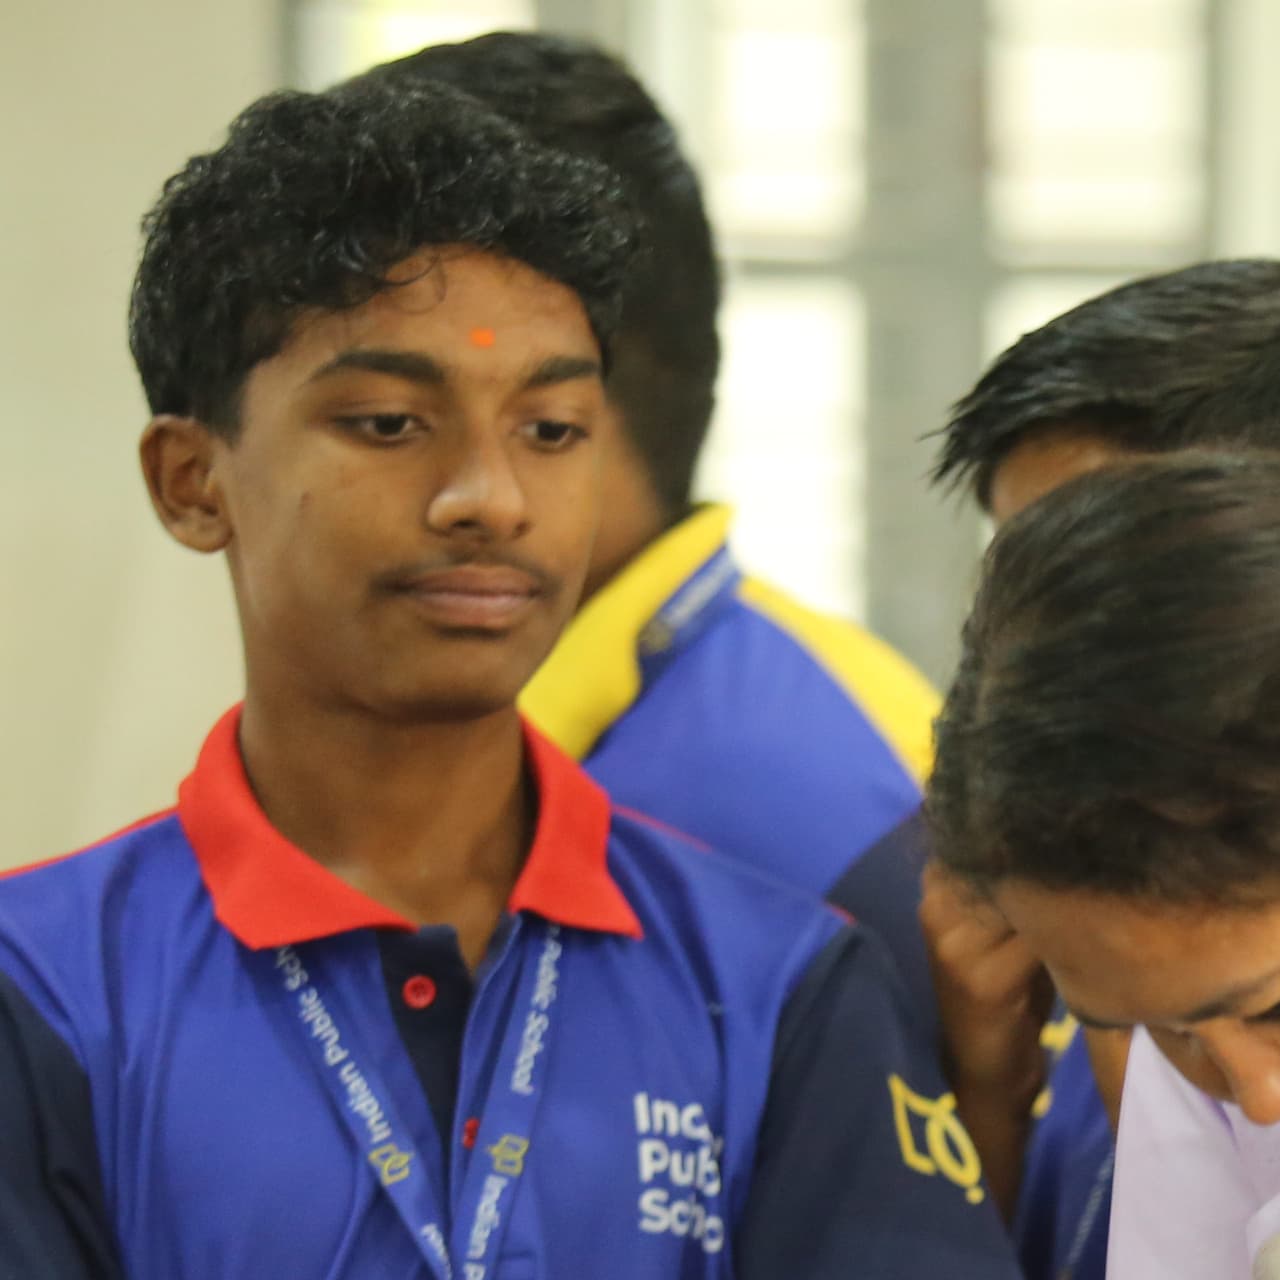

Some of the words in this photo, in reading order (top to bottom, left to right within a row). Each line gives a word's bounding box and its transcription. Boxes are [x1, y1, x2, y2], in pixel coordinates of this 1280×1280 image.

[274, 943, 309, 992] Sch
[299, 985, 350, 1067] Public
[511, 1009, 549, 1095] School
[338, 1059, 393, 1145] Indian
[638, 1137, 722, 1197] Pub
[466, 1174, 509, 1260] Indian
[638, 1187, 725, 1255] Scho
